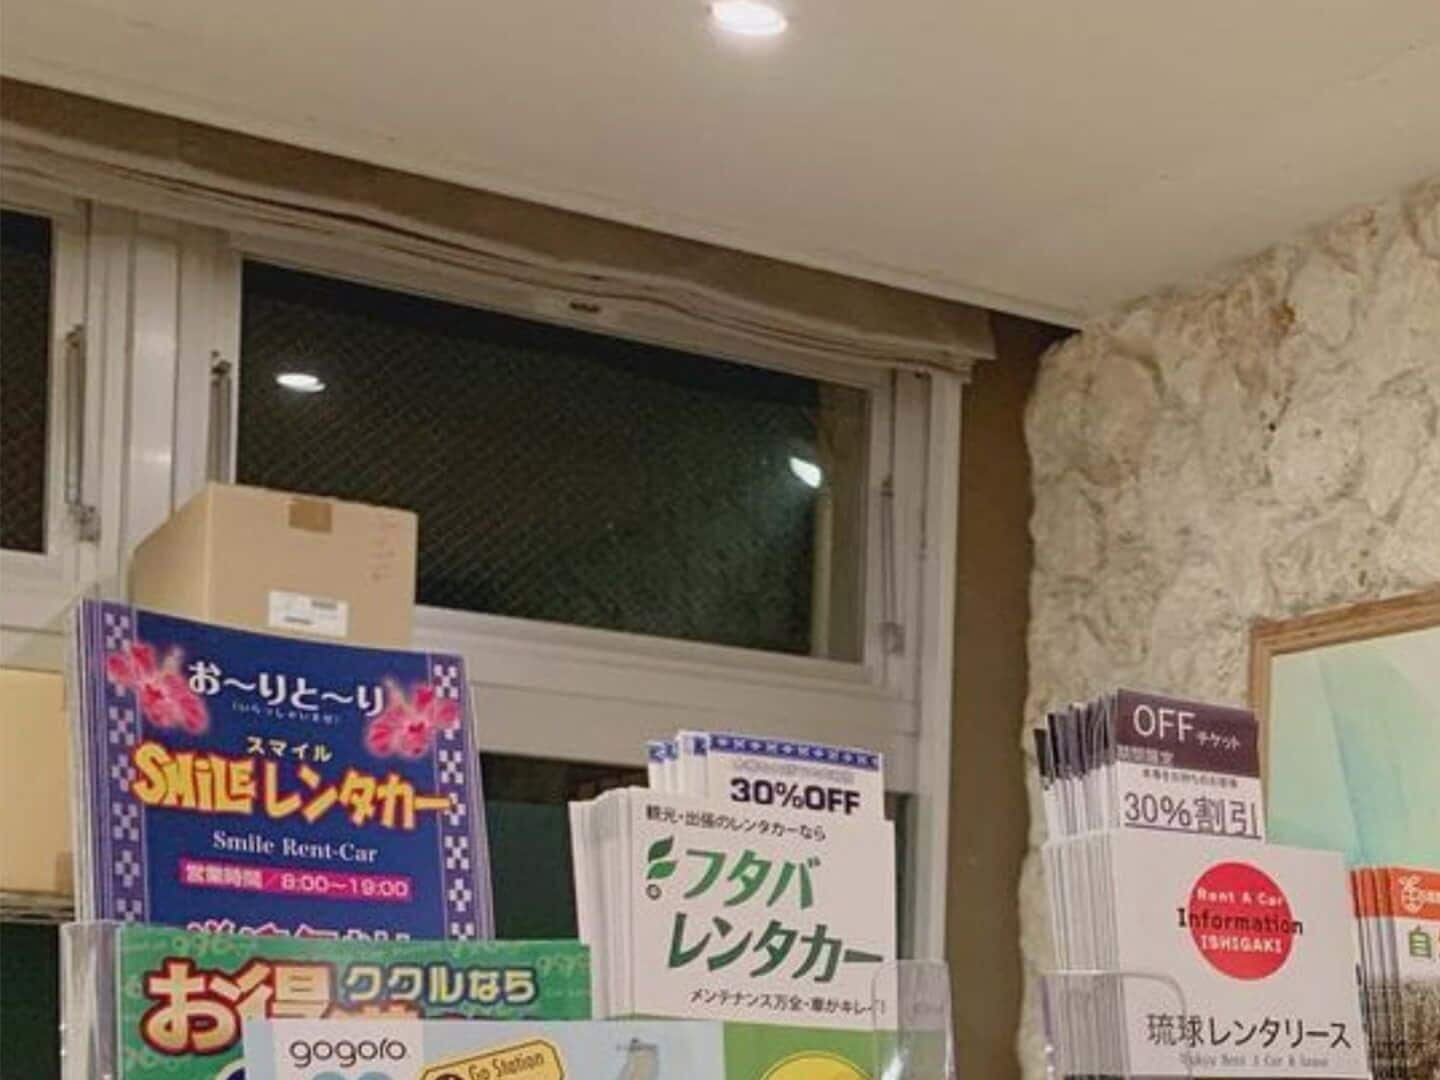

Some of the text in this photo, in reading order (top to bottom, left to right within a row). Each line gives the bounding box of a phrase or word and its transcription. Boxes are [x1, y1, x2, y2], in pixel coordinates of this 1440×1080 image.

[1133, 705, 1195, 744] OFF
[247, 736, 332, 763] スマイル
[730, 777, 860, 815] 30%OFF
[1124, 792, 1259, 836] 30%割引
[213, 830, 379, 865] Smile Rent-Car
[684, 849, 821, 908] フタバ
[1197, 887, 1237, 903] Rent
[1258, 892, 1282, 906] Car
[1176, 907, 1303, 936] Information
[668, 911, 883, 982] レンタカー
[1201, 934, 1282, 955] ISHIGAKI
[342, 965, 537, 1005] ククルなら
[1147, 1013, 1352, 1050] 琉球レンタリース
[290, 1039, 407, 1068] gogoro
